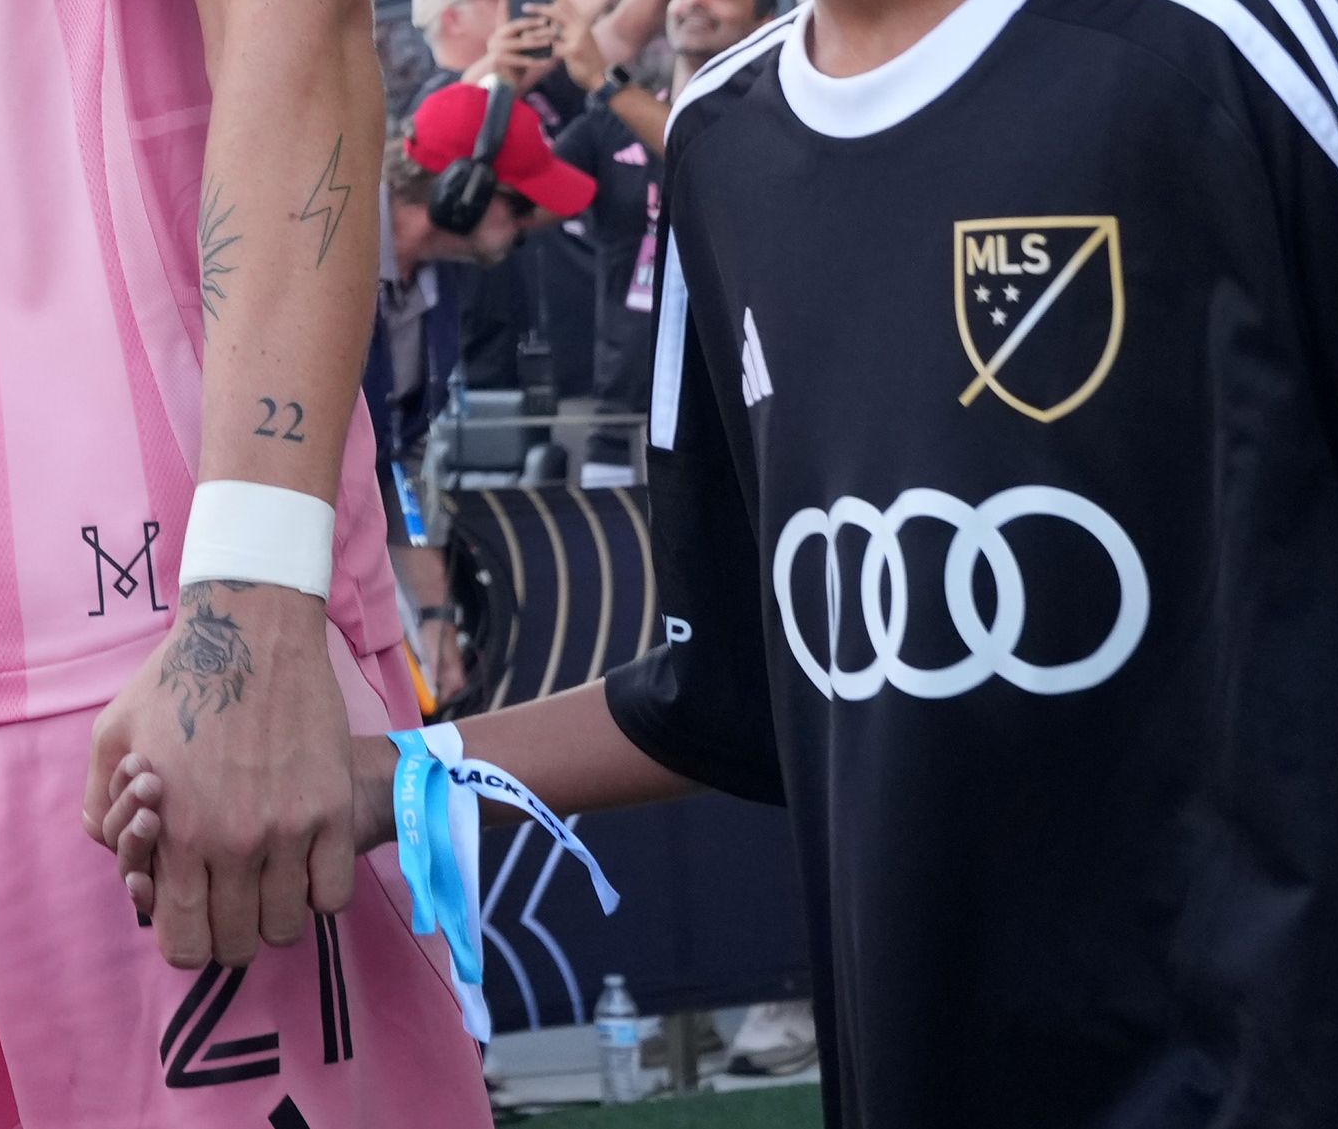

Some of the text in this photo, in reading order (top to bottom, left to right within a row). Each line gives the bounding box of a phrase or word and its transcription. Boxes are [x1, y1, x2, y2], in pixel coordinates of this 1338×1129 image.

[965, 233, 1051, 276] MLS
[254, 397, 305, 443] 22
[448, 768, 522, 799] LACK
